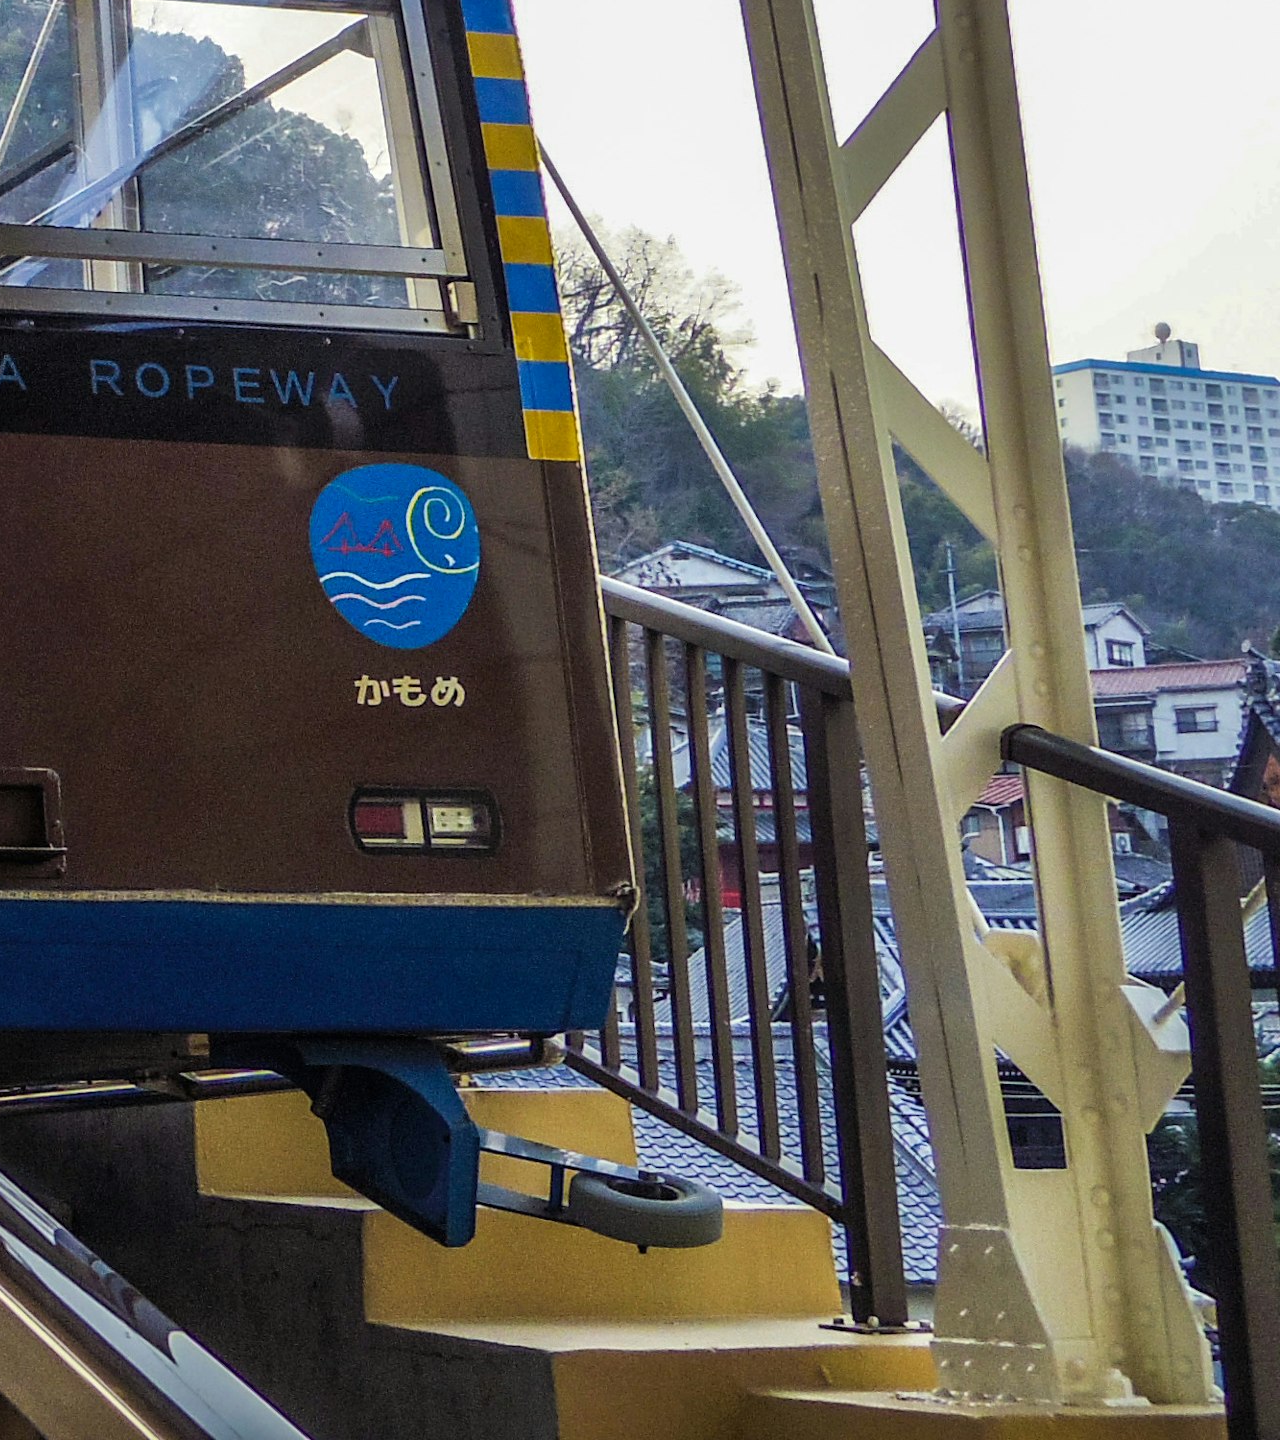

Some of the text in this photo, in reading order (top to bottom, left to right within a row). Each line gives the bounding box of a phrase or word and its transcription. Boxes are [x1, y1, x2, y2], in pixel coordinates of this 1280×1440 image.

[90, 359, 399, 410] ROPEWAY
[354, 674, 466, 707] かもめ
